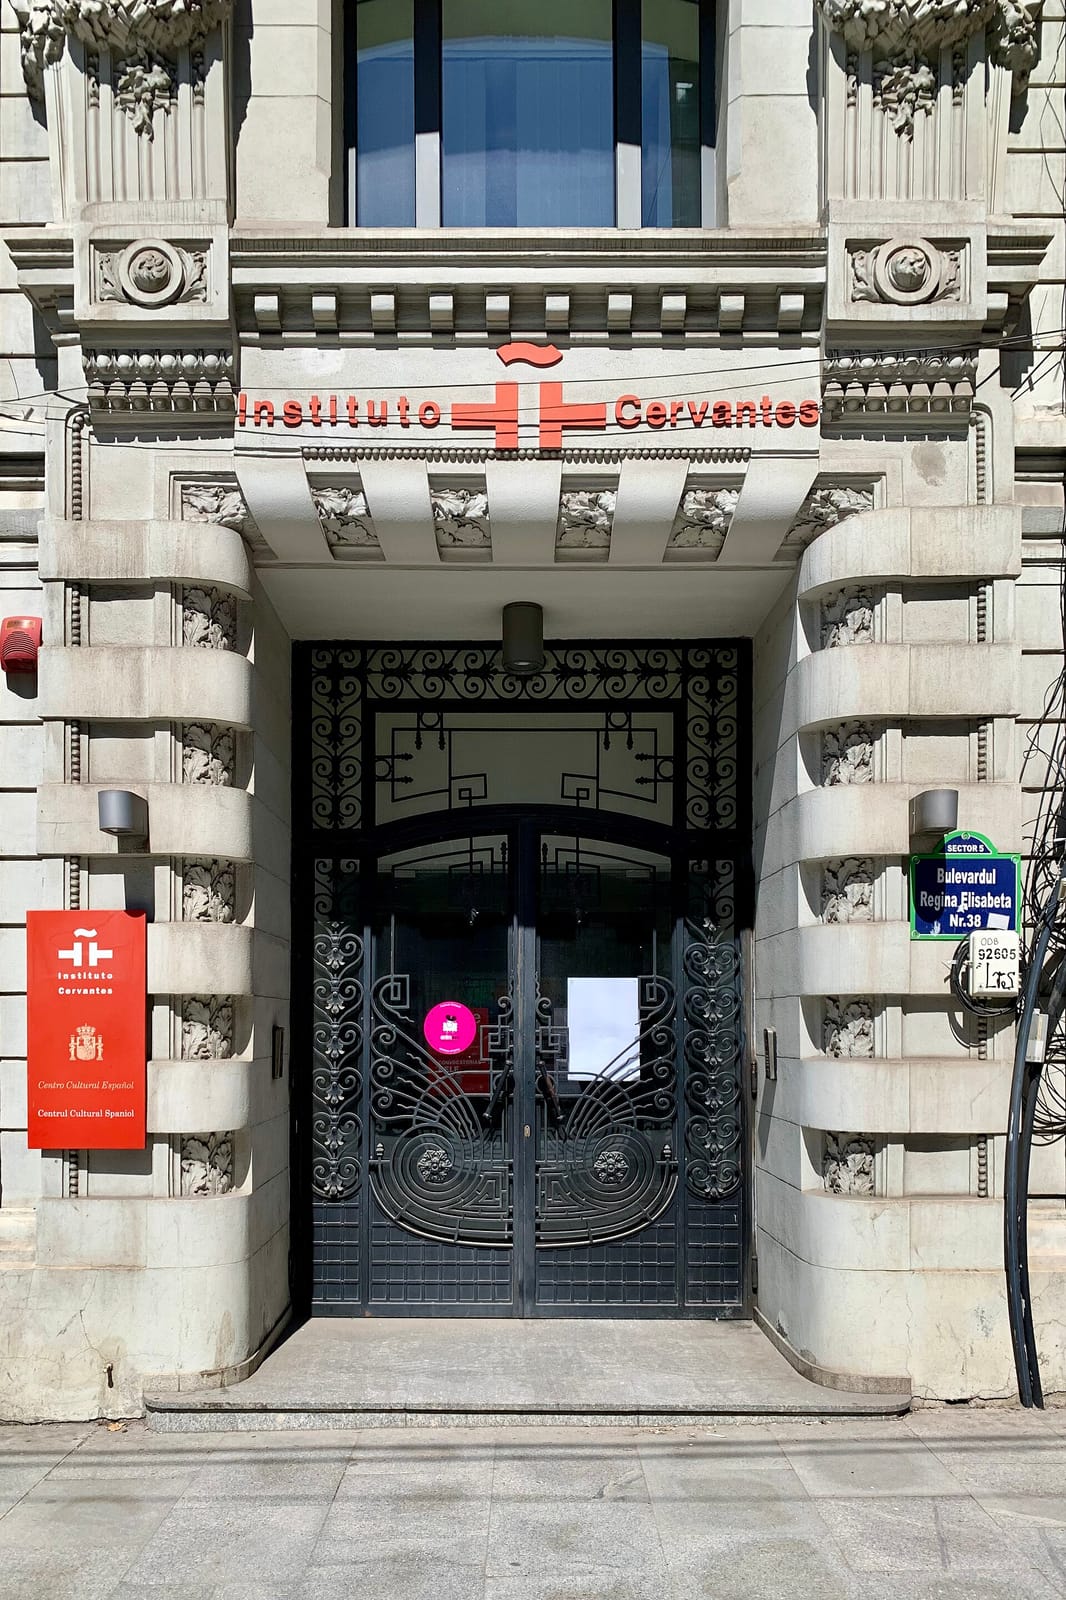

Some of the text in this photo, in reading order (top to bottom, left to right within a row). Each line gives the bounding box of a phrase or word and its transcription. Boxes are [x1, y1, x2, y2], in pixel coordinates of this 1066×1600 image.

[238, 393, 820, 429] Instituto Cervantes
[947, 844, 985, 852] SECTOR 5
[937, 867, 996, 884] Bulevardul
[920, 890, 1012, 911] Regina Elisabeta
[949, 914, 981, 928] Nr.38
[978, 948, 1017, 960] 92605
[57, 971, 113, 980] Instituto
[58, 986, 113, 995] Cervantes
[38, 1081, 135, 1091] Centro Cultural Español
[38, 1109, 135, 1119] Centrul Cultural Spaniol
